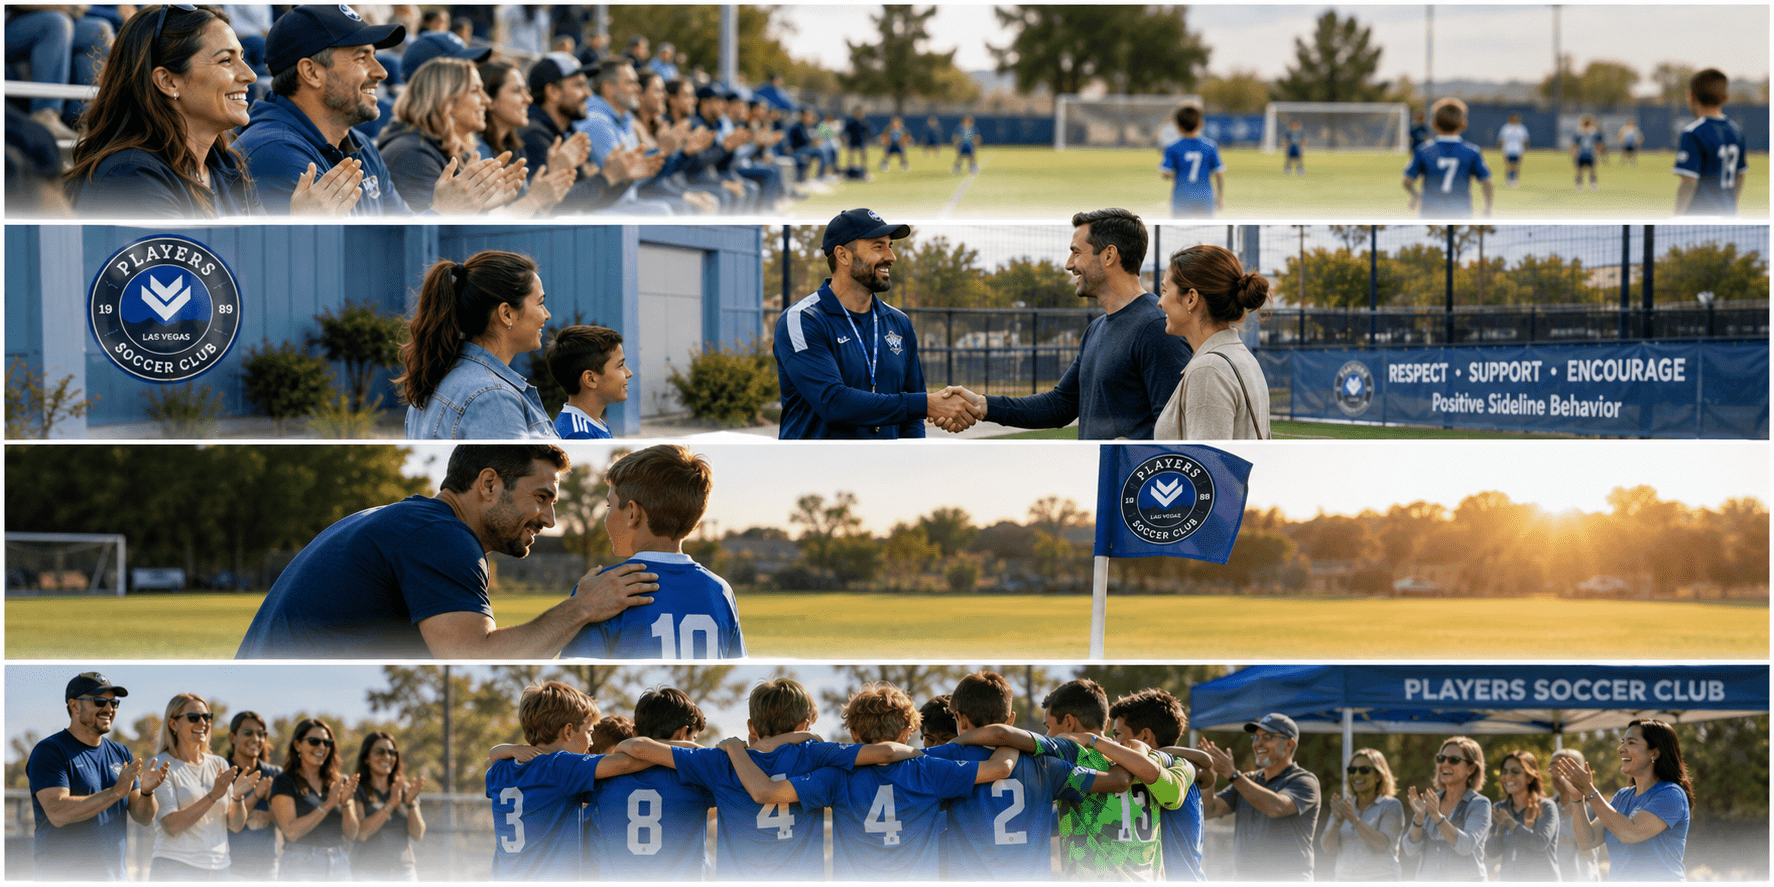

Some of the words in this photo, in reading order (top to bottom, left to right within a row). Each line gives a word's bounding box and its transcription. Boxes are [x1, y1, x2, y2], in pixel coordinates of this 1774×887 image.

[1184, 151, 1203, 182] 7
[1437, 157, 1460, 193] 7
[116, 244, 216, 276] PLAYERS
[98, 304, 113, 315] 19
[218, 304, 233, 314] 89
[142, 333, 160, 341] LAS
[161, 333, 191, 341] VEGAS
[115, 342, 174, 373] SOCCER
[179, 342, 217, 370] CLUB
[1388, 362, 1449, 383] RESPECT
[1468, 360, 1543, 383] SUPPORT
[1567, 357, 1686, 382] ENCOURAGE
[1431, 391, 1485, 413] Positive
[1487, 392, 1546, 416] Sideline
[1550, 393, 1622, 418] Behavior
[1136, 458, 1201, 481] PLAYERS
[1132, 520, 1169, 540] SOCCER
[1172, 518, 1198, 538] CLUB
[651, 613, 719, 660] 10
[1404, 678, 1526, 701] PLAYERS
[1533, 679, 1647, 701] SOCCER
[1653, 679, 1725, 701] CLUB
[500, 786, 526, 853] 3
[627, 789, 662, 855] 8
[756, 773, 795, 840] 4
[864, 784, 903, 846] 4
[991, 778, 1028, 845] 2
